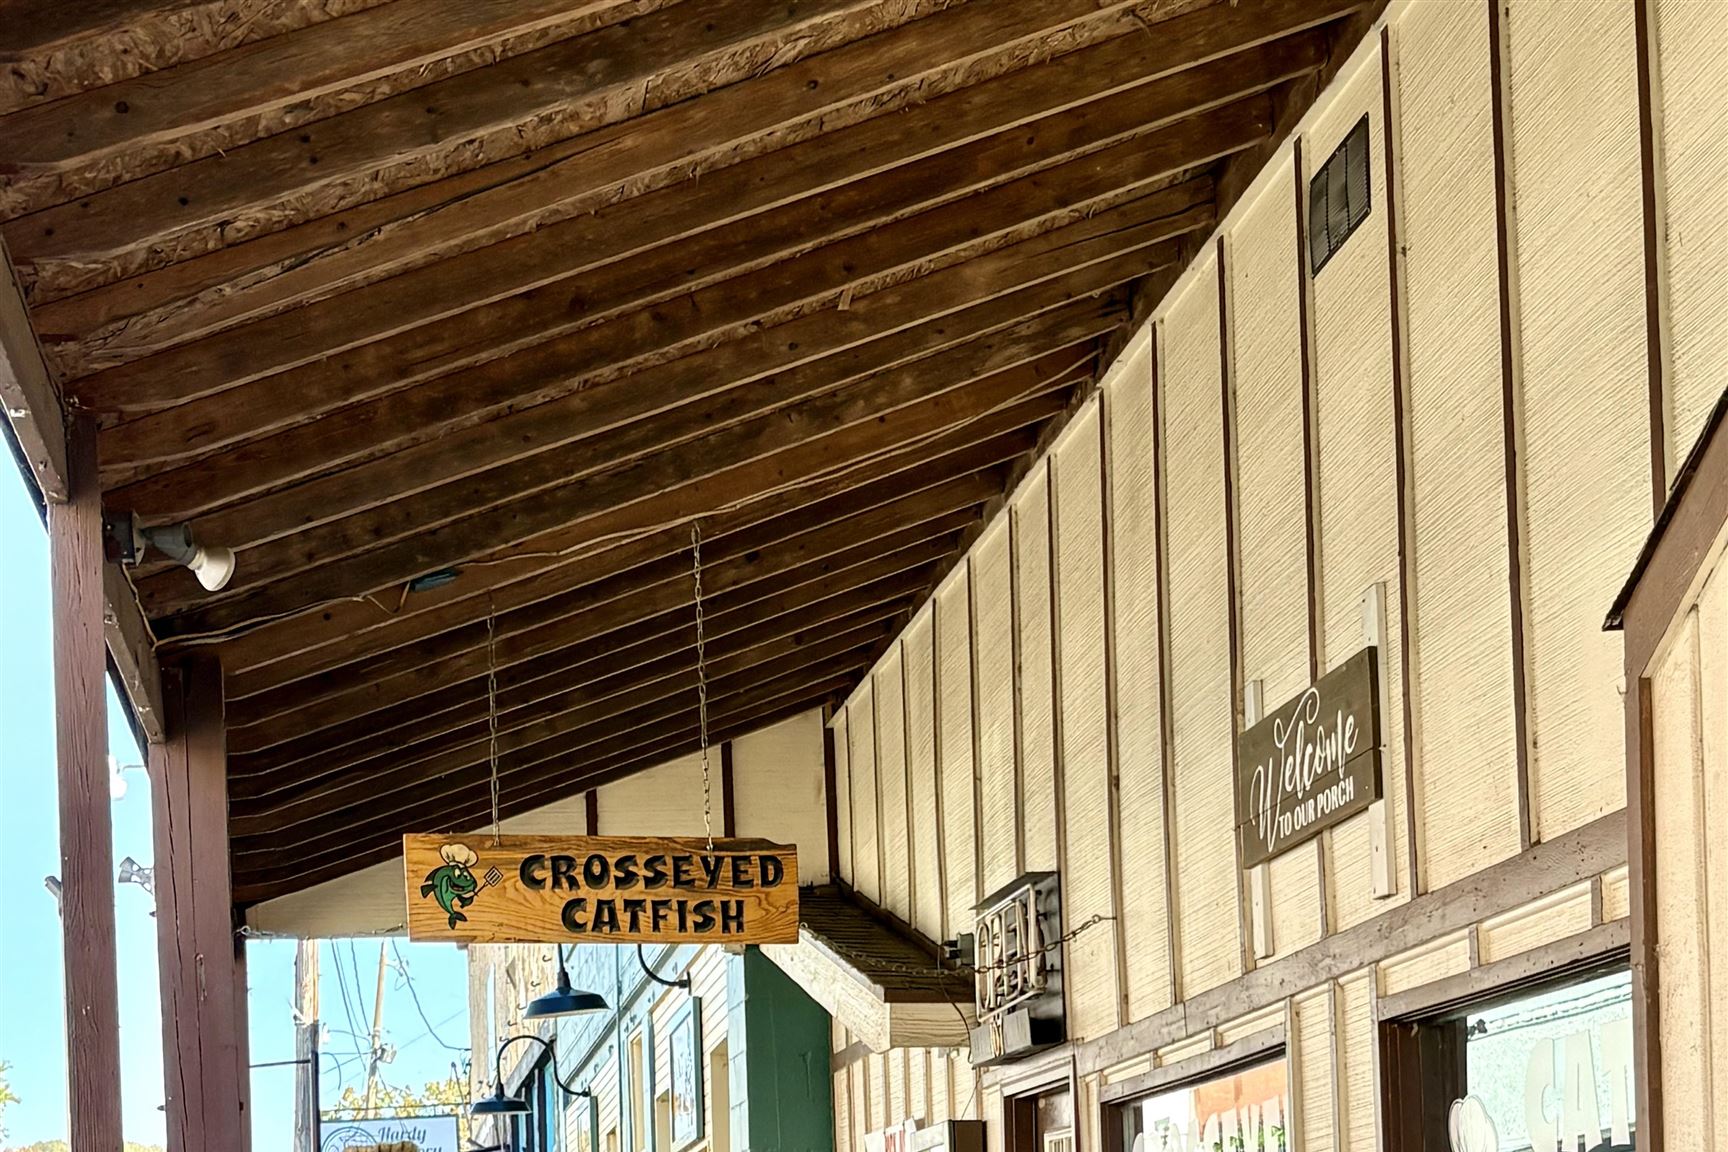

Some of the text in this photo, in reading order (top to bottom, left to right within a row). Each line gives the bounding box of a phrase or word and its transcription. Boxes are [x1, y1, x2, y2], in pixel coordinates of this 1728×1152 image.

[1250, 687, 1359, 853] Welcome
[1279, 776, 1354, 839] TO OUR PORCH
[519, 853, 785, 891] CROSSEYED
[561, 897, 745, 934] CATFISH
[378, 1125, 427, 1145] Hardy
